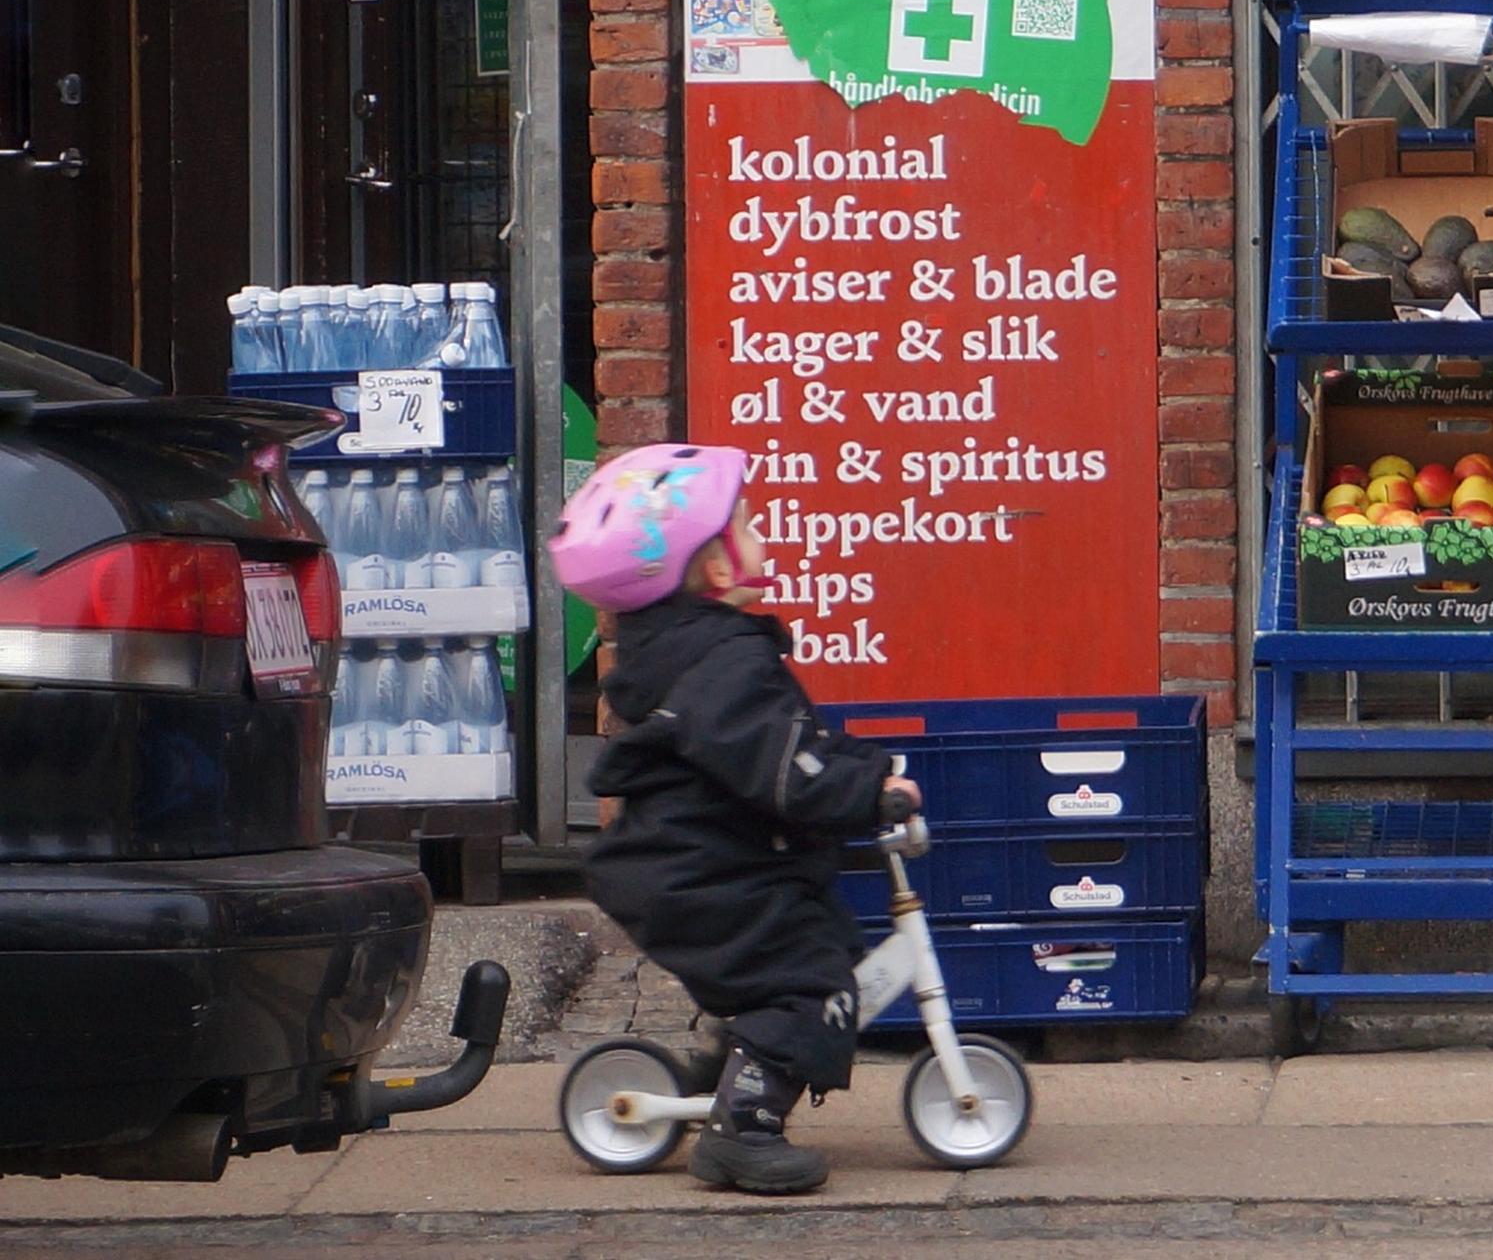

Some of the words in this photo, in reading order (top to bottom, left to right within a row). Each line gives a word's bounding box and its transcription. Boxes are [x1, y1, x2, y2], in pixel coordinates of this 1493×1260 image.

[727, 134, 948, 182] kolonial
[728, 195, 961, 256] dybfrost
[728, 257, 891, 304] aviser
[908, 259, 956, 301] &
[972, 254, 1118, 300] blade
[729, 317, 878, 376] kager
[896, 320, 943, 362] &
[962, 314, 1059, 361] slik
[366, 391, 382, 412] 3
[731, 377, 781, 425] øl
[800, 381, 846, 424] &
[863, 376, 997, 423] vand
[1419, 385, 1493, 404] Frugthave
[741, 439, 818, 484] vin
[836, 441, 882, 483] &
[901, 437, 1107, 495] spiritus
[345, 595, 427, 617] RAMLÖSA
[761, 559, 874, 617] hips
[1348, 596, 1433, 623] Ørskovs
[779, 620, 888, 664] bak
[327, 761, 407, 782] RAMLÖSA
